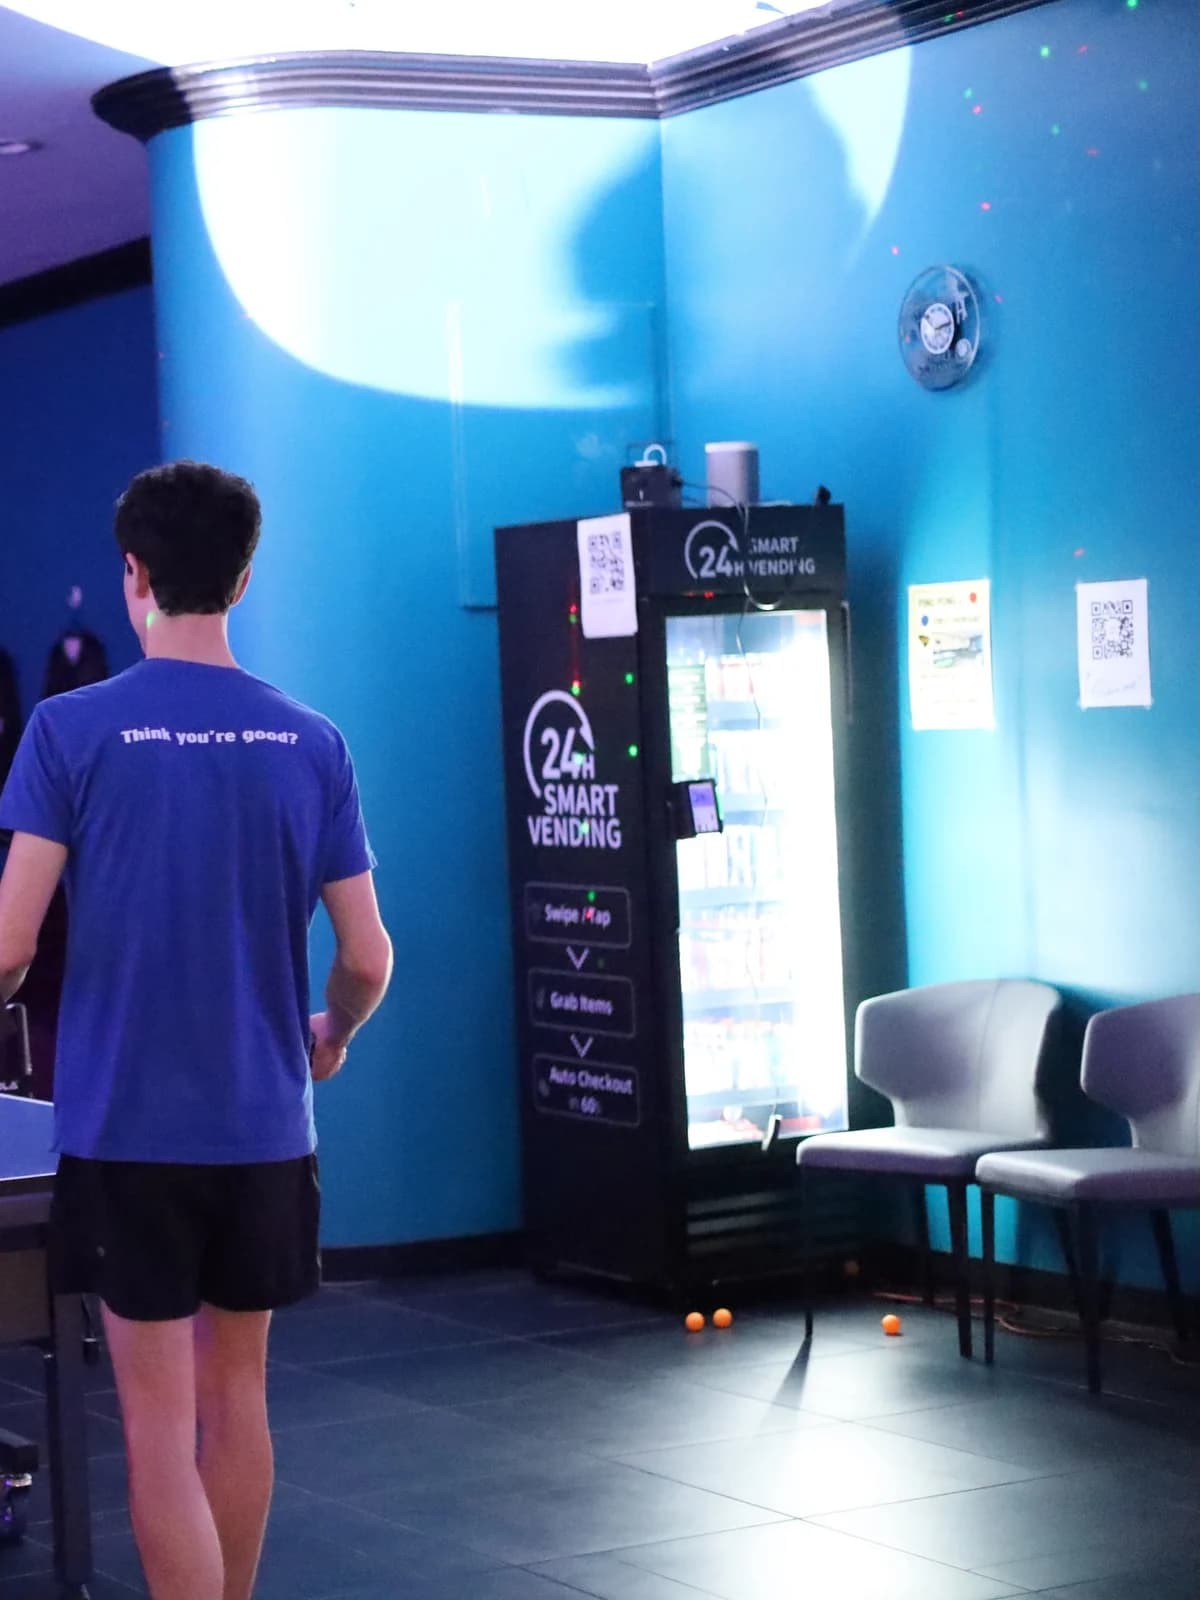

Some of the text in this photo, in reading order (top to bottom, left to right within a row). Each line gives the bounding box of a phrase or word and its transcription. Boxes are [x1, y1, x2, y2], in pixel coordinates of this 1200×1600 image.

[120, 727, 299, 745] Think you're good?
[544, 783, 619, 817] SMART
[528, 815, 622, 850] VENDING
[544, 903, 579, 928] Swipe
[550, 992, 612, 1016] Grab Items
[550, 1066, 632, 1095] Auto Checkout
